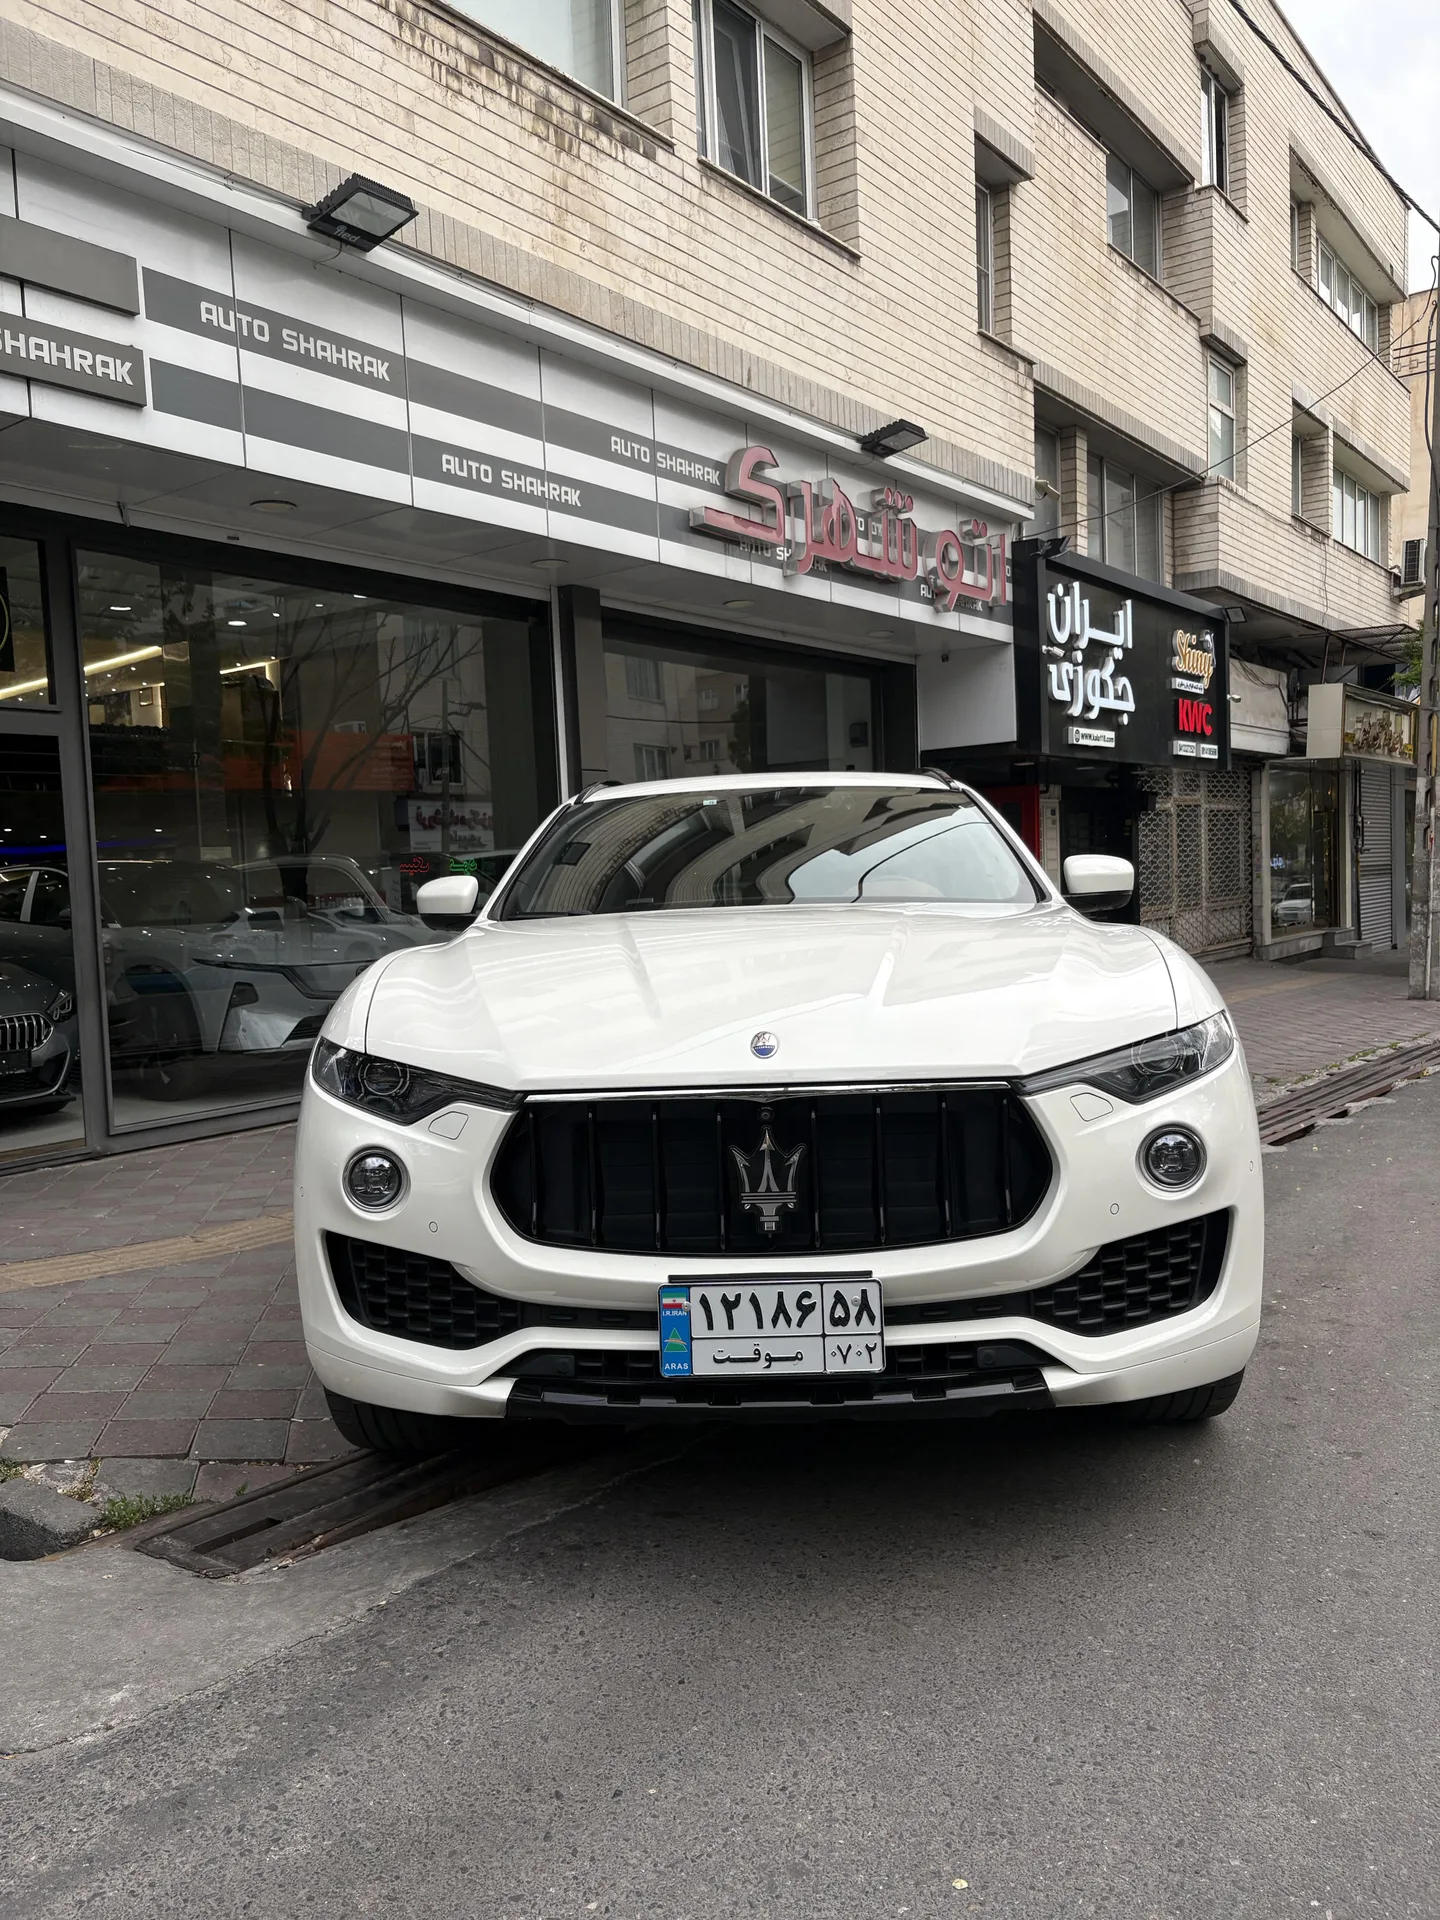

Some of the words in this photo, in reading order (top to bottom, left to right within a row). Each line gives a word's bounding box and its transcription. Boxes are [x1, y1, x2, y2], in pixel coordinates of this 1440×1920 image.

[0, 328, 134, 386] HAHRAK
[200, 300, 270, 343] AUTO
[281, 328, 391, 382] SHAHRAK
[441, 454, 493, 484] AUTO
[501, 470, 582, 508] SHAHRAK
[610, 435, 650, 463] AUTO
[656, 452, 721, 487] SHAHRAK
[1047, 580, 1133, 661] ایران
[1174, 628, 1214, 690] Shiny
[1178, 697, 1213, 736] KWC
[698, 1289, 817, 1331] ۱۲۱۸۶
[829, 1288, 877, 1328] ۵۸
[664, 1362, 689, 1370] ARAS
[712, 1342, 804, 1369] موقت
